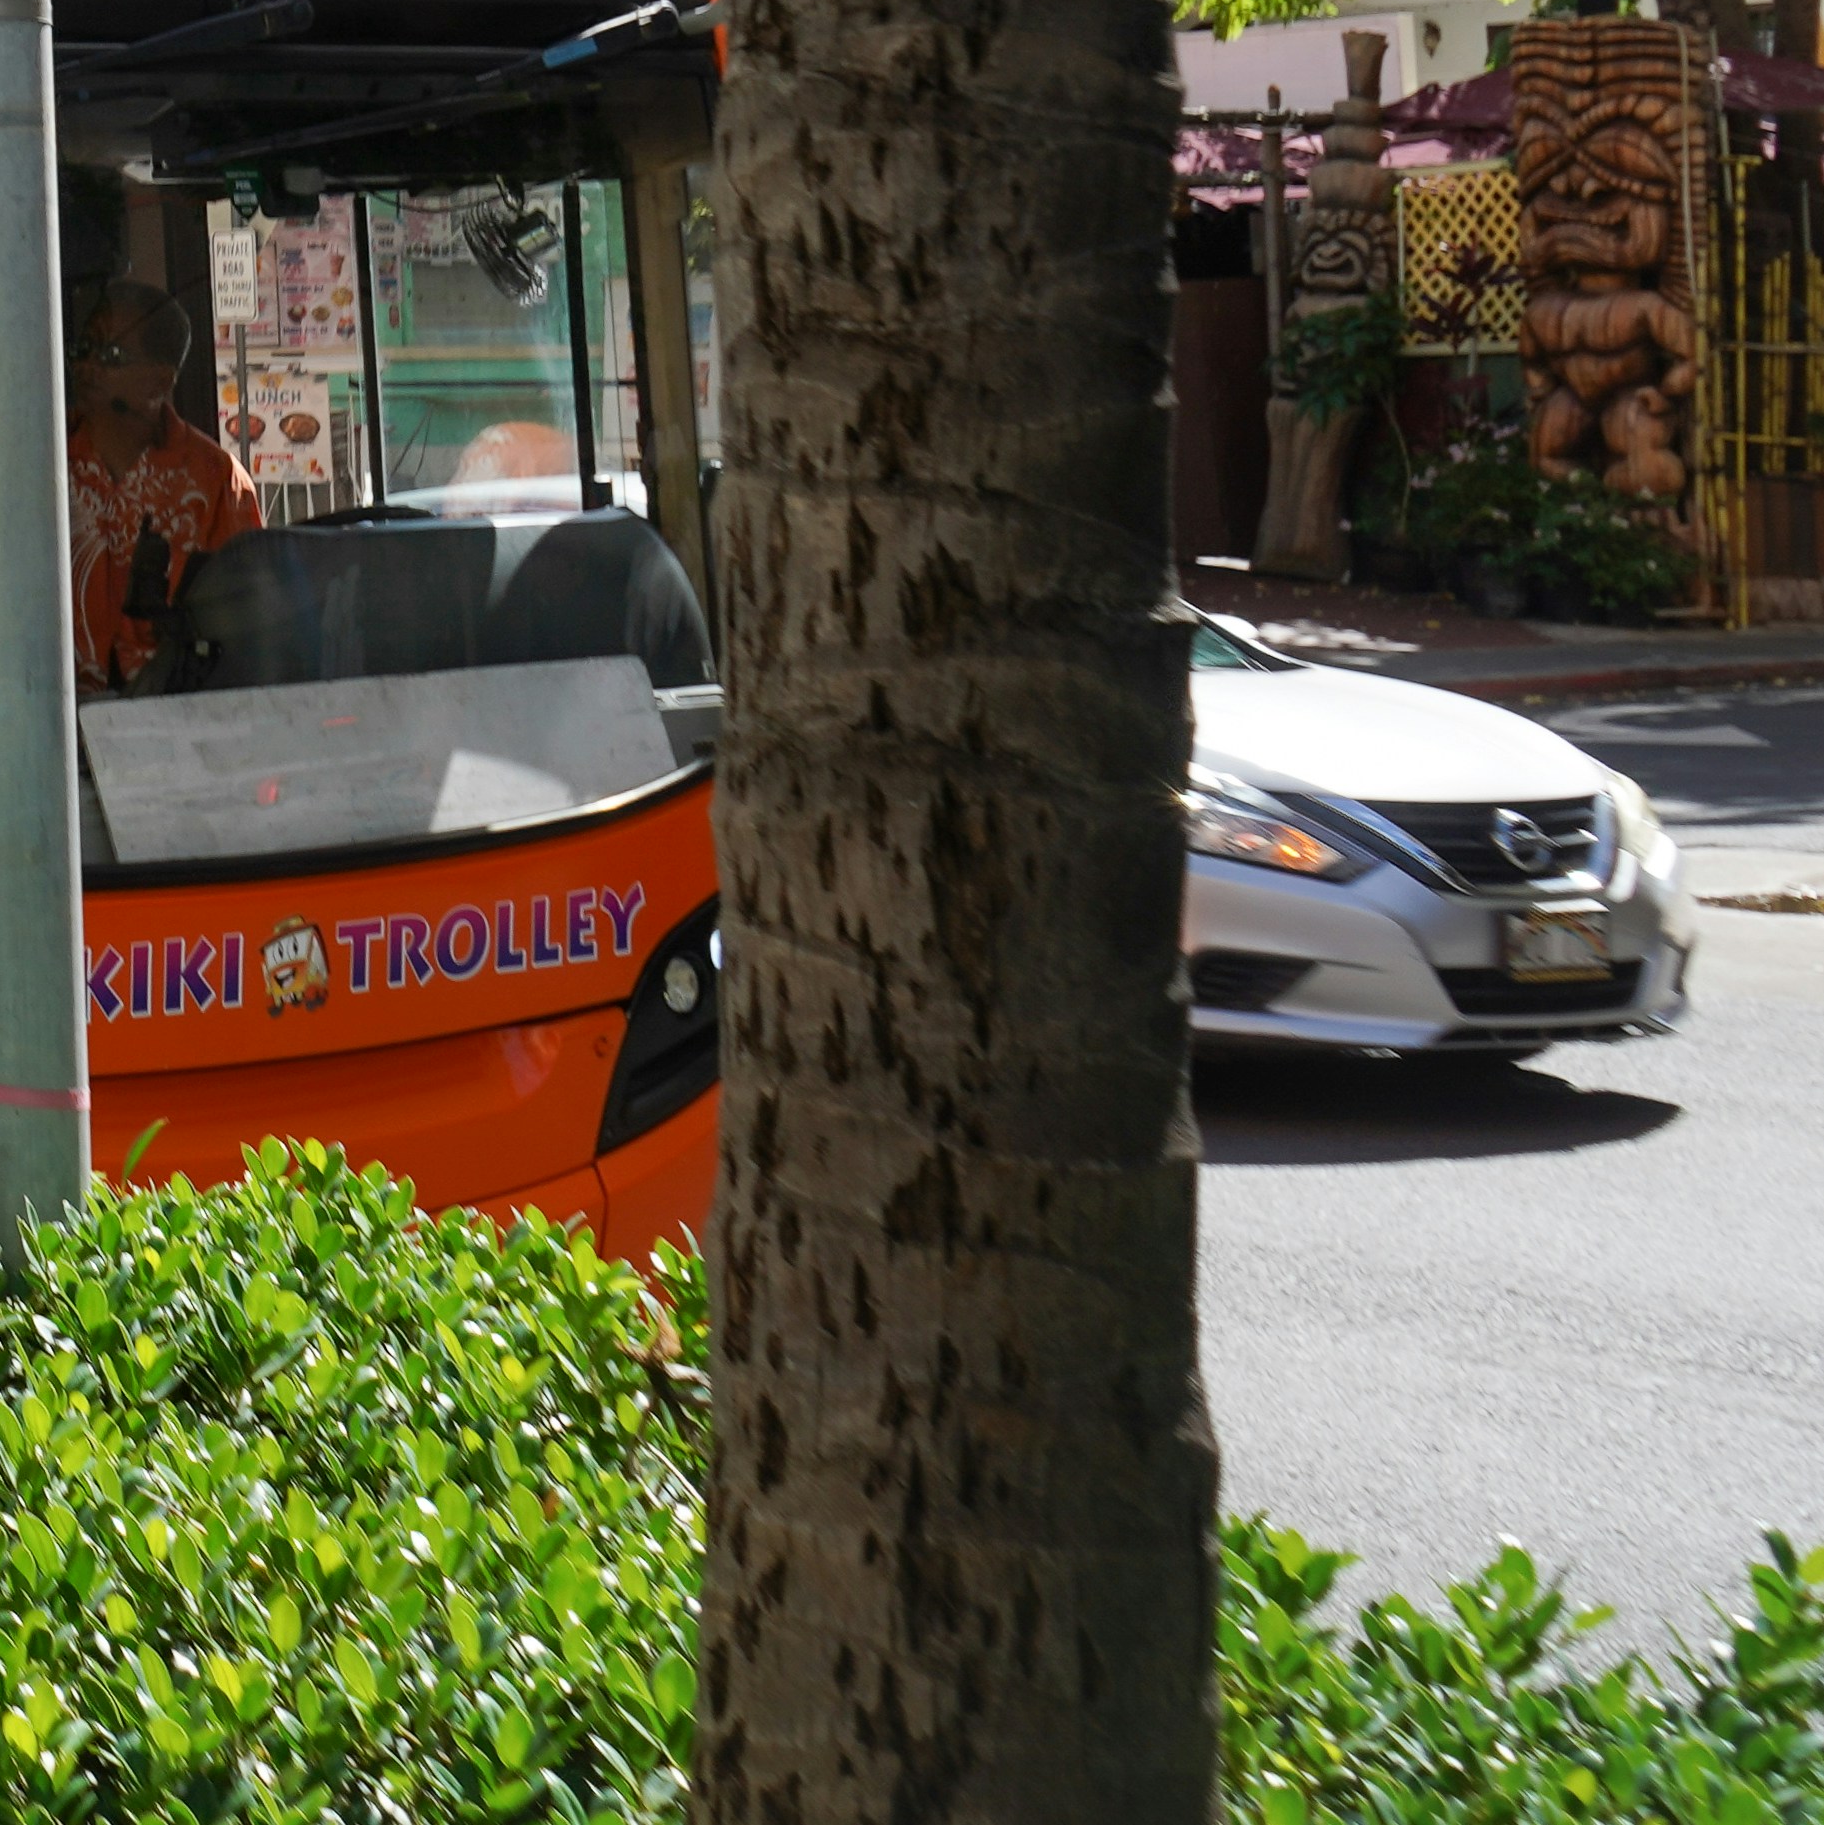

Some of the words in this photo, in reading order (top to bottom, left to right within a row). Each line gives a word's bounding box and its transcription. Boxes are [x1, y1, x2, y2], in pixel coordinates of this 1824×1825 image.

[216, 241, 249, 257] PRIVATE
[223, 261, 244, 276] ROAD
[255, 389, 301, 405] UNCH
[84, 932, 244, 1022] KIKI
[336, 881, 646, 993] TROLLEY
